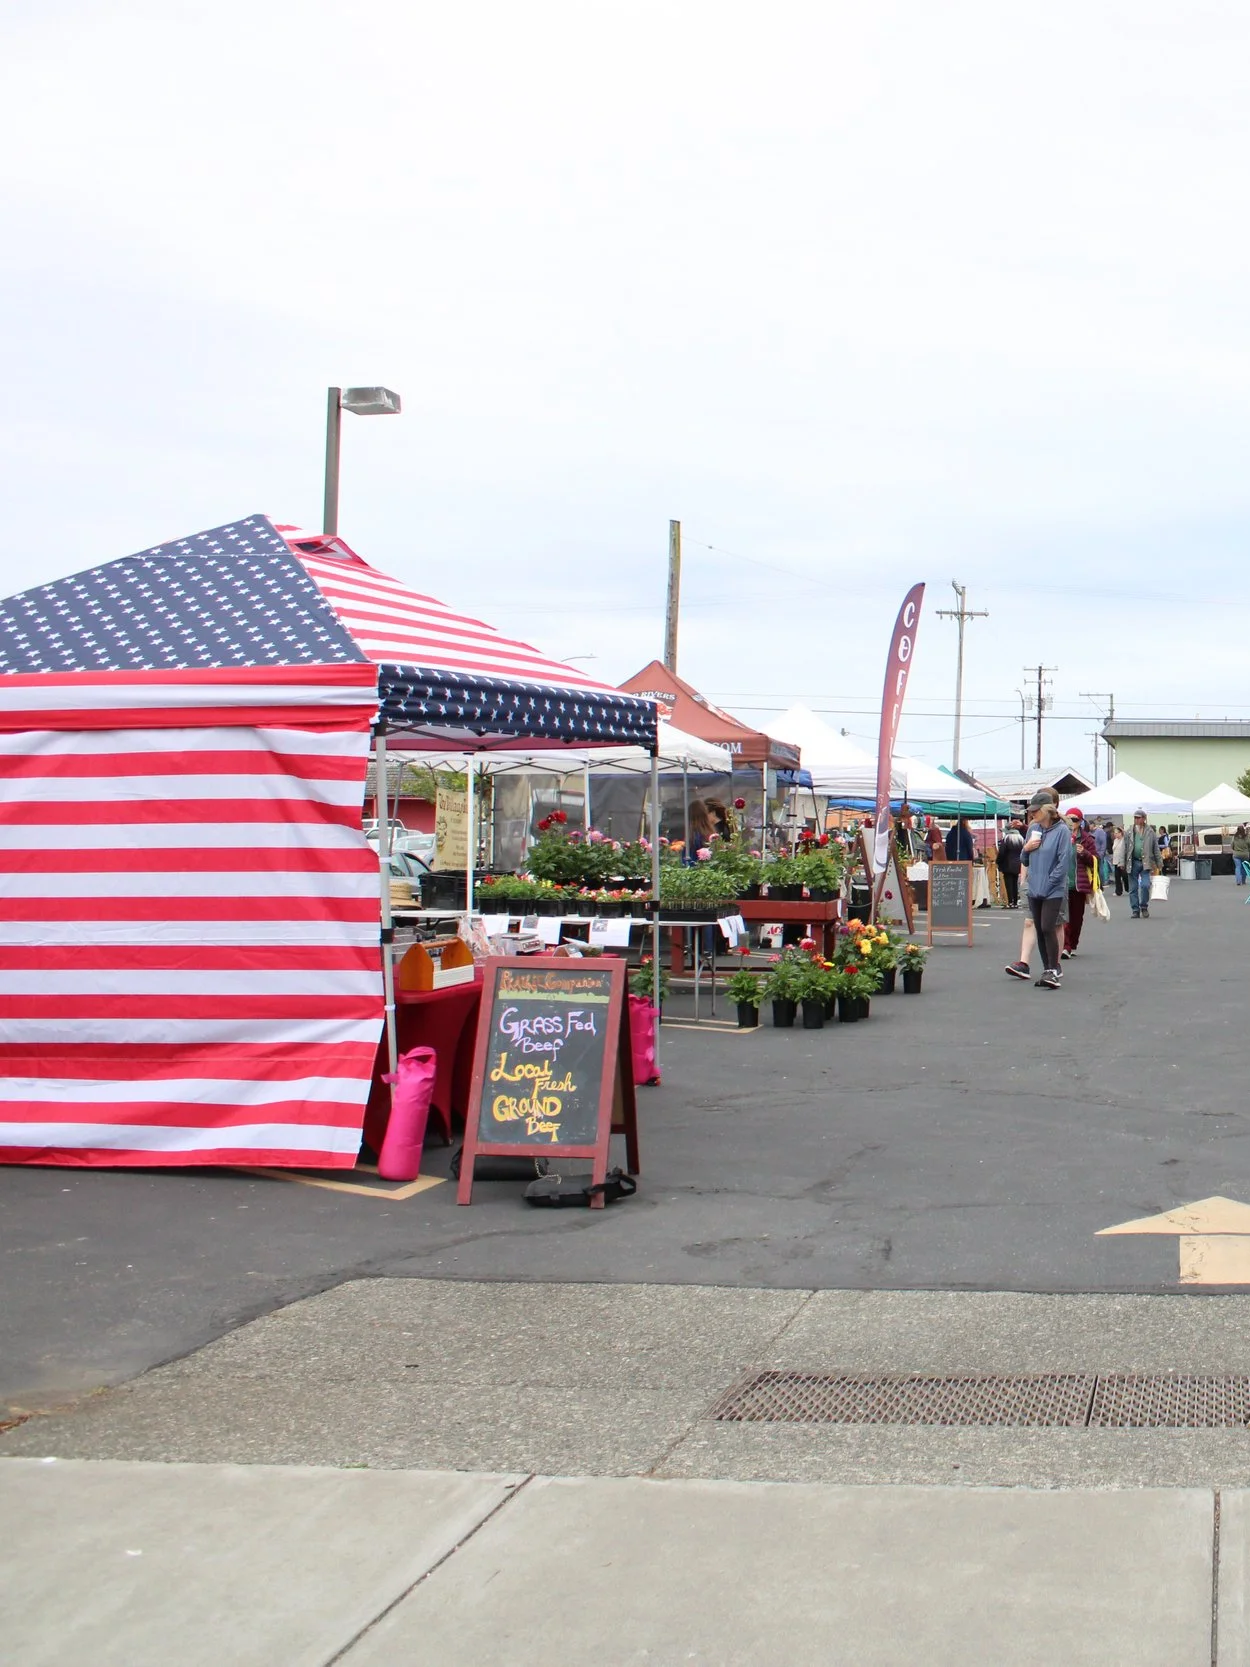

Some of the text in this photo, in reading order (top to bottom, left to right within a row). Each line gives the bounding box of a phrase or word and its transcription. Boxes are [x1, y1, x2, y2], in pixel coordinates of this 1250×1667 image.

[565, 1011, 596, 1038] Fed
[514, 1036, 564, 1062] Beef
[531, 1071, 577, 1099] Fresh
[492, 1094, 562, 1122] GROUND
